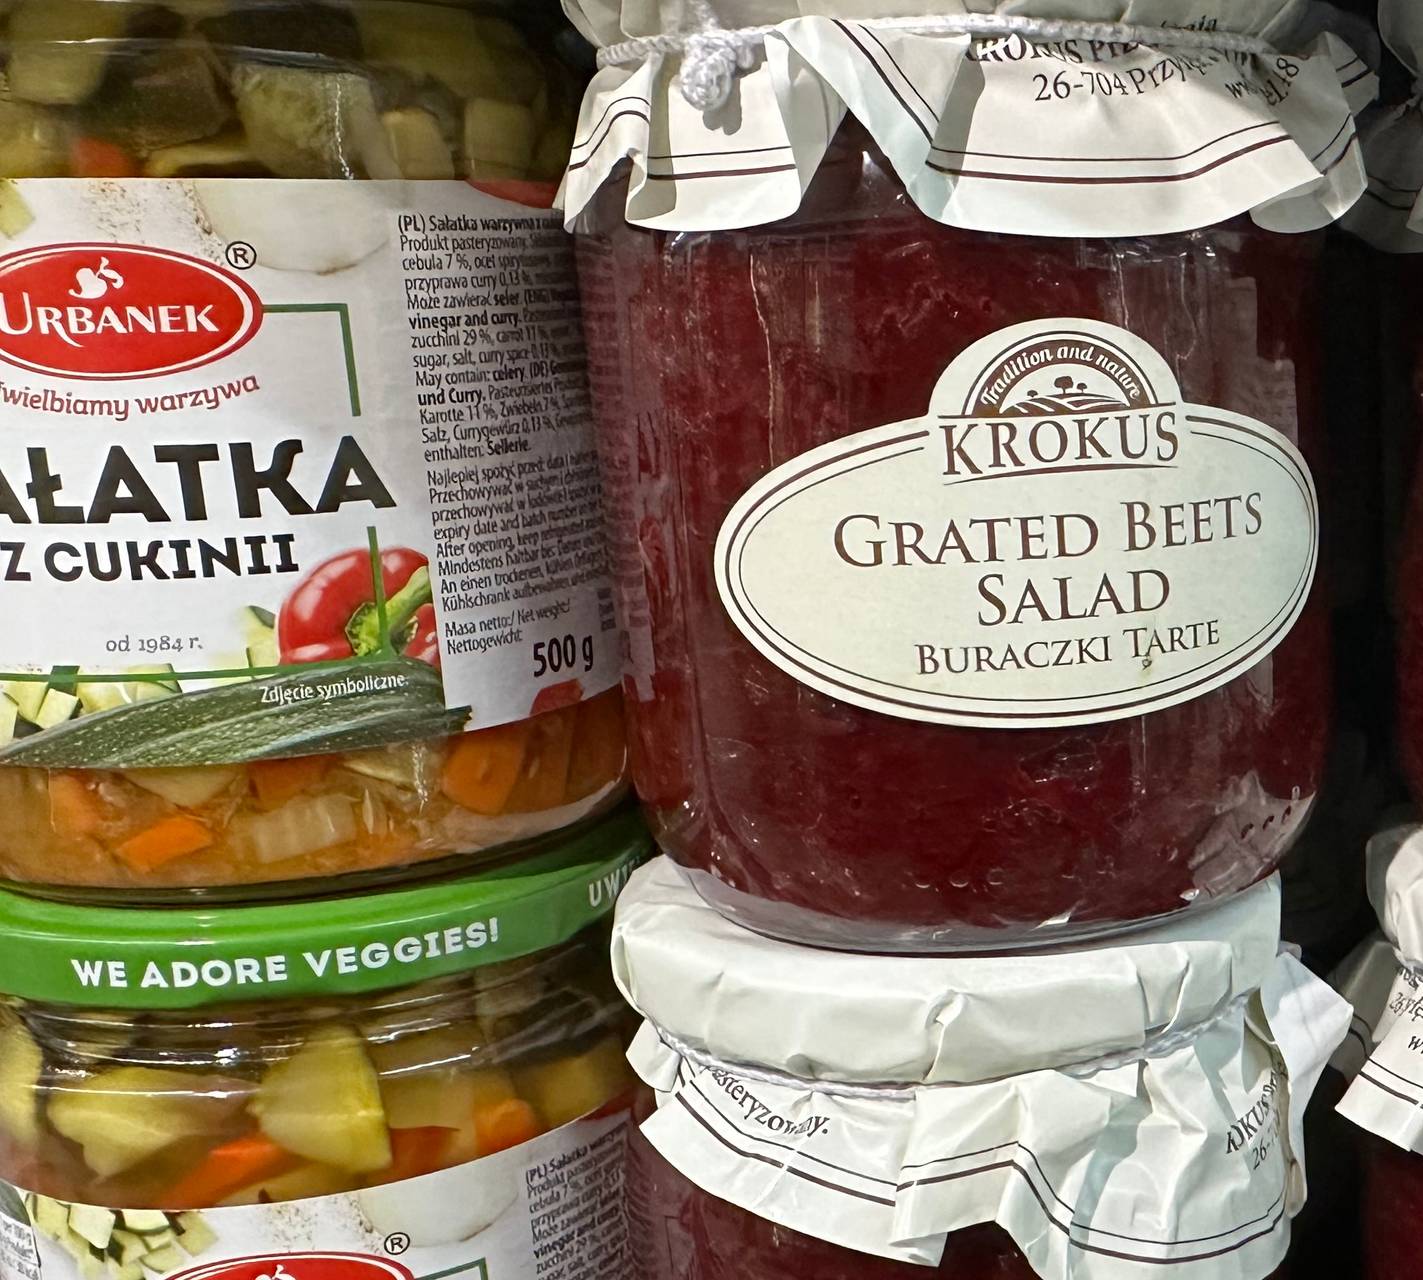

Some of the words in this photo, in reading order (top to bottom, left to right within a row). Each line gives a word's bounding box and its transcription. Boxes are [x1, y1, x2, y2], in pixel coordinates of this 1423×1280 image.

[1033, 70, 1129, 101] 26-704
[398, 212, 426, 234] (PL)
[400, 234, 449, 251] Produkt
[402, 253, 442, 271] cebula
[445, 253, 452, 269] 7
[405, 276, 468, 294] przyprawa
[0, 291, 219, 348] URBANEK
[408, 312, 462, 332] vinegar
[464, 310, 488, 326] and
[411, 330, 460, 348] zucchini
[463, 329, 477, 346] 29
[413, 354, 450, 371] sugar,
[416, 371, 442, 389] May
[445, 368, 490, 385] contain:
[980, 348, 1054, 405] Tradition
[1057, 346, 1095, 362] and
[1096, 354, 1141, 399] nature
[0, 381, 129, 422] wielbiamy
[136, 374, 261, 415] warzywa
[418, 388, 445, 406] und
[448, 387, 486, 404] Curry.
[419, 407, 465, 424] Karotte
[467, 404, 481, 421] 11
[422, 427, 450, 443] Salz,
[940, 411, 1179, 476] KROKUS
[427, 465, 479, 488] Najlepiej
[429, 480, 514, 504] Przechowywać
[434, 523, 470, 543] expiry
[473, 519, 498, 536] date
[834, 513, 1099, 568] GRATED
[1121, 491, 1263, 552] BEETS
[0, 541, 32, 581] Z
[44, 533, 300, 582] CUKINII
[436, 542, 465, 558] After
[438, 555, 504, 577] Mindestens
[441, 578, 457, 595] An
[460, 573, 492, 592] einen
[977, 568, 1171, 627] SALAD
[445, 621, 476, 639] Masa
[106, 635, 130, 653] od
[138, 636, 183, 655] 1984
[189, 636, 204, 651] r.
[533, 634, 577, 678] 500
[581, 635, 593, 672] g
[914, 635, 1112, 675] BURACZKI
[1123, 620, 1221, 660] TARTE
[259, 683, 314, 706] Zdjęcie
[317, 675, 409, 700] symboliczne.
[71, 958, 128, 989] WE
[140, 954, 288, 989] ADORE
[302, 917, 501, 979] VEGGIES!
